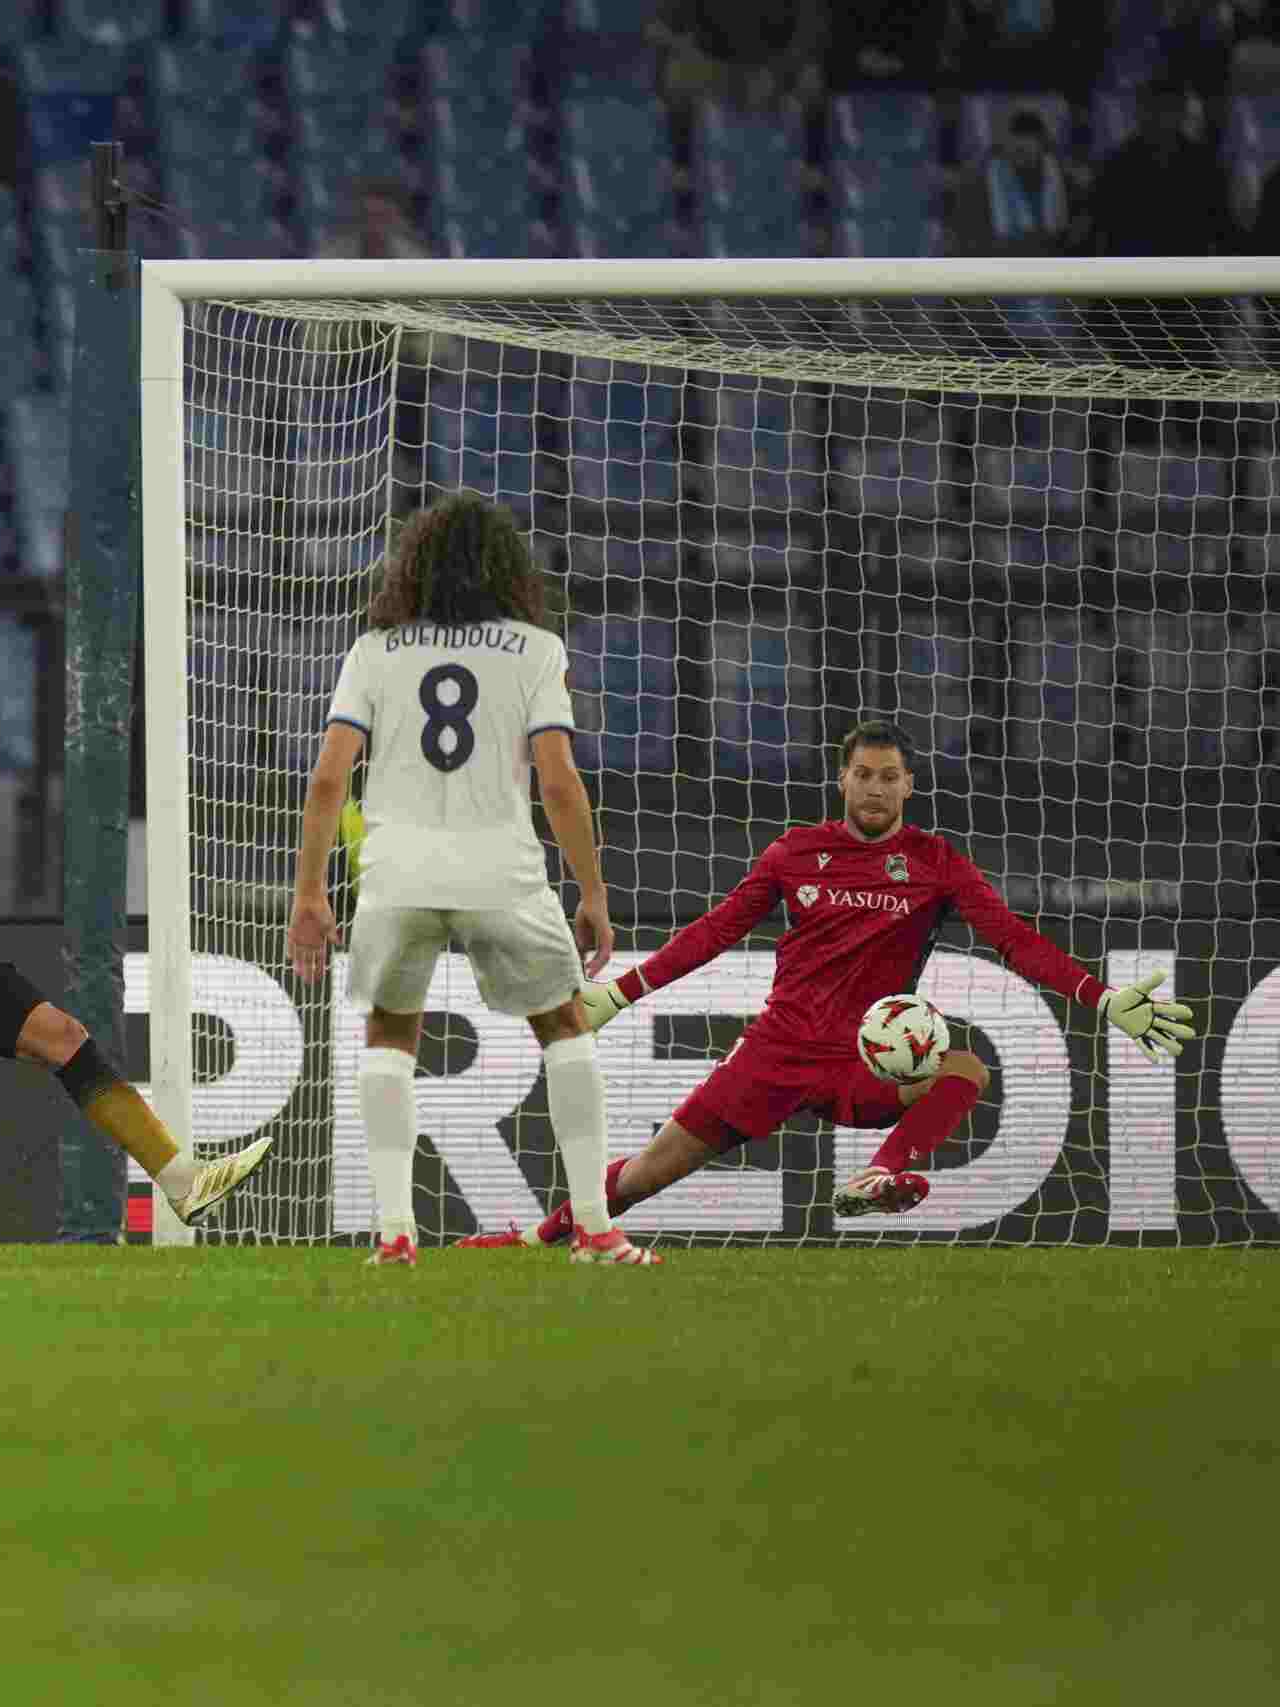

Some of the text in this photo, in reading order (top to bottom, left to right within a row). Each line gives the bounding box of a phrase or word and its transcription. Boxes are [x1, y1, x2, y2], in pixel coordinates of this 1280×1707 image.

[385, 623, 526, 655] GUENDOUZI
[419, 664, 478, 773] 8
[826, 888, 911, 915] YASUDA
[122, 951, 1280, 1234] PREDI
